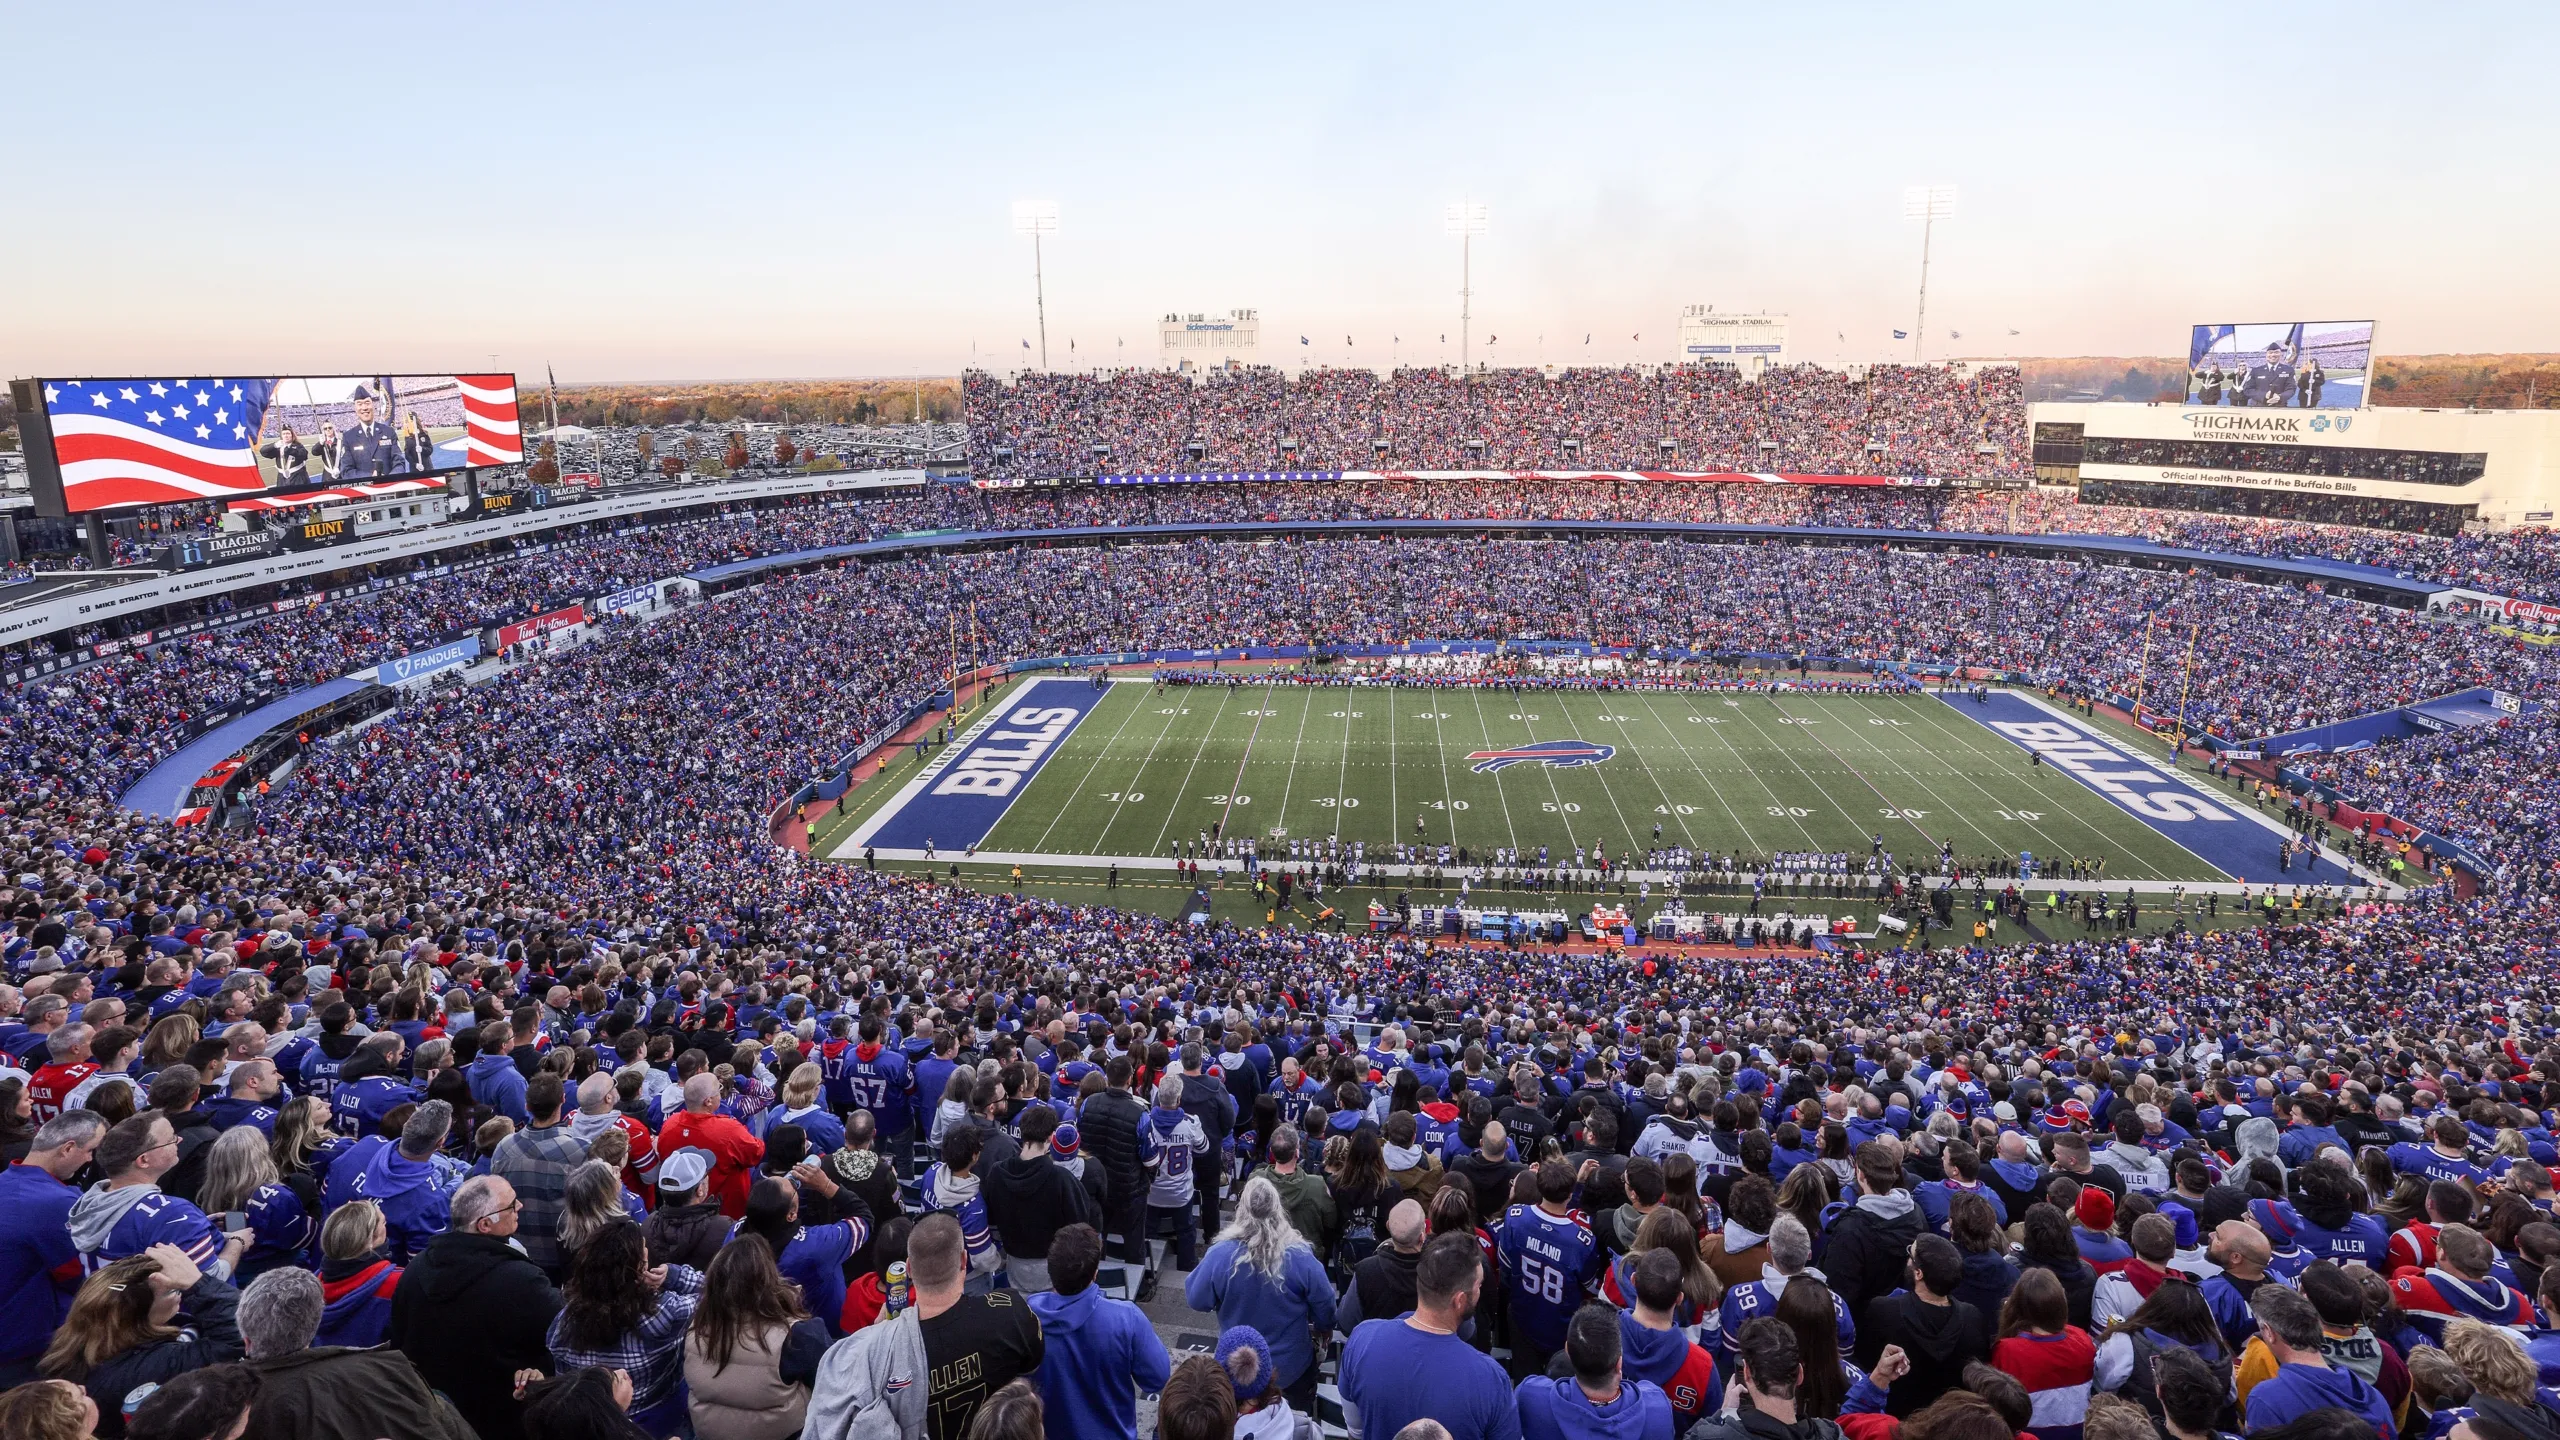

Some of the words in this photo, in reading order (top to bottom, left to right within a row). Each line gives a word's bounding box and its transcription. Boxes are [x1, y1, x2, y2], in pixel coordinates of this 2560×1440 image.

[1186, 323, 1235, 331] ticketmaster
[2193, 415, 2301, 432] HIGHMARK
[2193, 431, 2240, 440] WESTERN
[2242, 433, 2268, 441] NEW
[2271, 434, 2300, 443] YORK
[2161, 471, 2198, 481] Official
[2200, 474, 2234, 483] Health
[2236, 476, 2258, 485] Plan
[2261, 477, 2272, 486] of
[2274, 478, 2291, 487] the
[2294, 480, 2332, 490] Buffalo
[2335, 482, 2357, 492] Bills
[551, 485, 586, 497] IMAGINE
[556, 494, 581, 502] STAFFING
[484, 495, 513, 510] HUNT
[626, 501, 652, 509] FERGUSON
[358, 511, 370, 522] 25
[724, 513, 735, 521] 202
[304, 520, 345, 538] HUNT
[619, 529, 629, 537] 201
[635, 526, 646, 534] 202
[209, 532, 270, 552] IMAGINE
[426, 536, 448, 544] WILSON
[220, 545, 262, 558] STAFFING
[341, 552, 354, 560] PAT
[264, 567, 275, 575] 70
[278, 563, 295, 572] TOM
[297, 558, 324, 569] SESTAK
[434, 566, 448, 576] 200
[169, 585, 181, 594] 44
[184, 579, 214, 590] ELBERT
[216, 571, 255, 584] DUBENION
[413, 571, 428, 581] 244
[79, 604, 91, 615] 58
[95, 599, 117, 610] MIKE
[119, 590, 160, 605] STRATTON
[606, 583, 657, 611] GEICO
[277, 600, 296, 612] 243
[27, 615, 50, 628] LEVY
[517, 622, 536, 641] Tim
[99, 640, 119, 656] 242
[414, 646, 465, 670] FANDUEL
[2503, 699, 2519, 711] 25
[2417, 716, 2442, 731] BILLS
[856, 734, 882, 761] BUFFALO
[883, 720, 900, 742] BILLS
[915, 773, 934, 781] IT
[927, 747, 961, 771] TAKES
[960, 733, 978, 746] ALL
[973, 723, 988, 731] OF
[931, 707, 1080, 797] BILLS
[1989, 720, 2238, 822] BILLS
[1109, 791, 1145, 802] 10
[1211, 795, 1252, 806] 20
[1320, 798, 1359, 808] 30
[1430, 800, 1470, 811] 40
[1541, 802, 1582, 813] 50
[1654, 804, 1695, 815] 40
[1766, 806, 1810, 818] 30
[1879, 808, 1924, 819] 20
[1994, 809, 2040, 821] 10
[2456, 852, 2475, 868] HOME
[608, 990, 618, 998] 17
[316, 1063, 340, 1074] McCOY
[598, 1059, 615, 1070] LLEN
[823, 1057, 844, 1081] 17
[857, 1063, 876, 1076] HULL
[1369, 1059, 1384, 1069] ALLEN
[31, 1086, 52, 1100] ALLEN
[850, 1076, 887, 1108] 67
[340, 1093, 361, 1110] ALLEN
[251, 1106, 275, 1121] 21
[1284, 1102, 1299, 1124] 17
[338, 1112, 360, 1138] 17
[1510, 1119, 1533, 1133] ALLEN
[1162, 1134, 1184, 1143] SMITH
[1425, 1131, 1445, 1143] COOK
[2359, 1130, 2391, 1141] MAHOMES
[1508, 1132, 1534, 1162] 17
[1661, 1141, 1686, 1152] SHAKIR
[1156, 1144, 1189, 1177] 78
[1715, 1152, 1740, 1164] ALLEN
[2425, 1165, 2459, 1183] ALLEN
[247, 1184, 280, 1211] 14
[135, 1193, 171, 1218] 17
[1526, 1235, 1562, 1263] MILANO
[2331, 1238, 2366, 1254] ALLEN
[1520, 1254, 1564, 1305] 58
[888, 1292, 908, 1302] HARD
[984, 1291, 1013, 1308] 17
[1734, 1284, 1759, 1311] 99
[1674, 1385, 1698, 1411] S
[927, 1382, 987, 1440] 17
